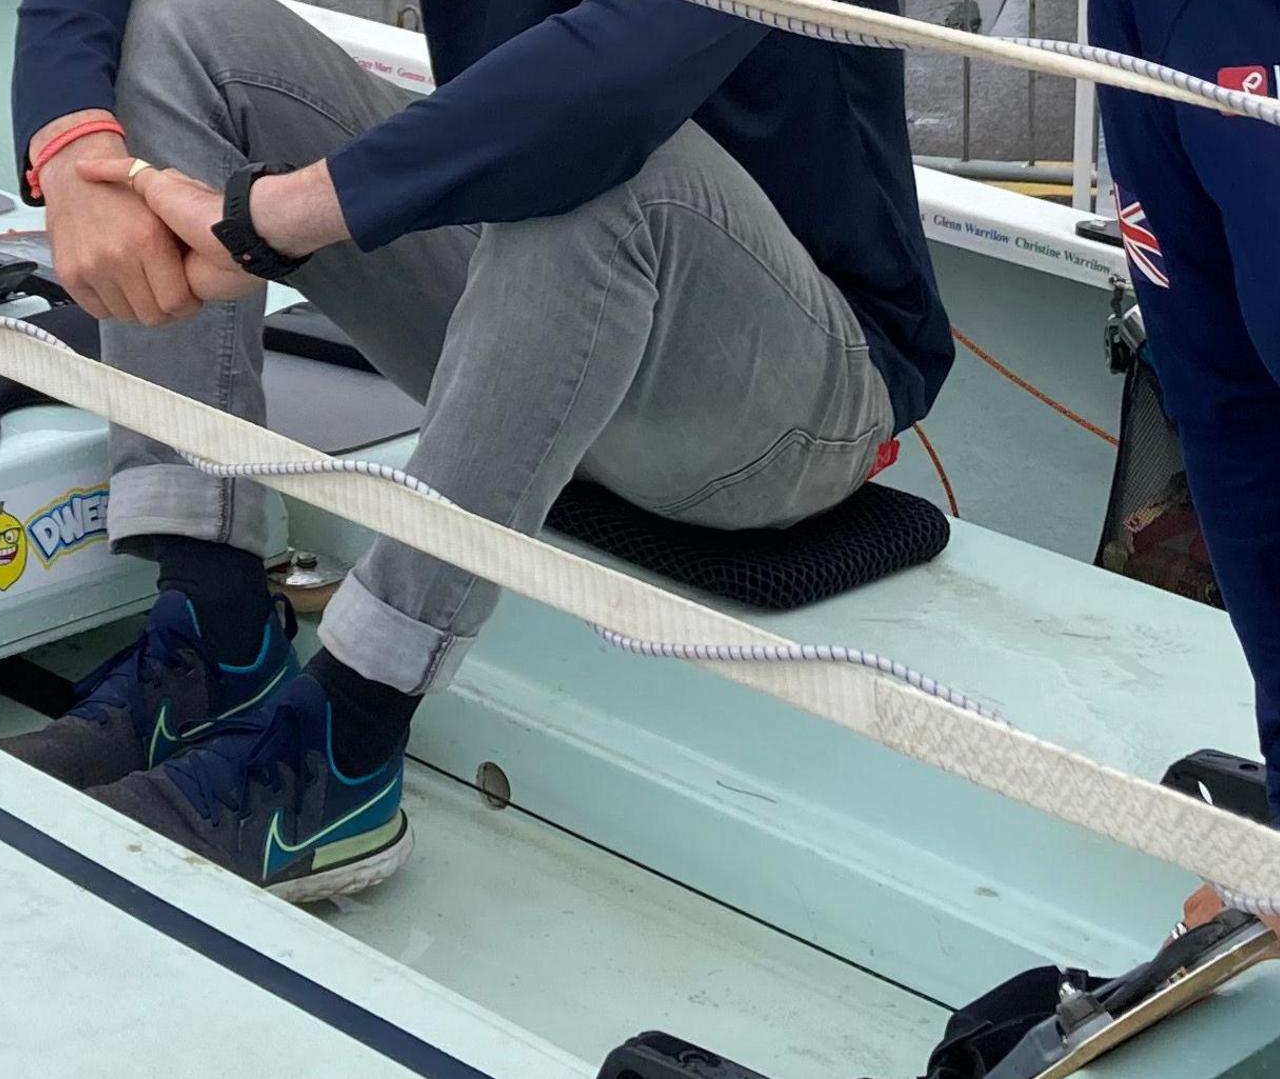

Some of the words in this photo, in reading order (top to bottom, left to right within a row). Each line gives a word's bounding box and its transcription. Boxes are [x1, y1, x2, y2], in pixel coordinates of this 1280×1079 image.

[933, 214, 962, 232] Glenn
[965, 222, 1011, 245] Warrilow
[1015, 236, 1062, 259] Christine
[1064, 249, 1111, 274] Warrilow
